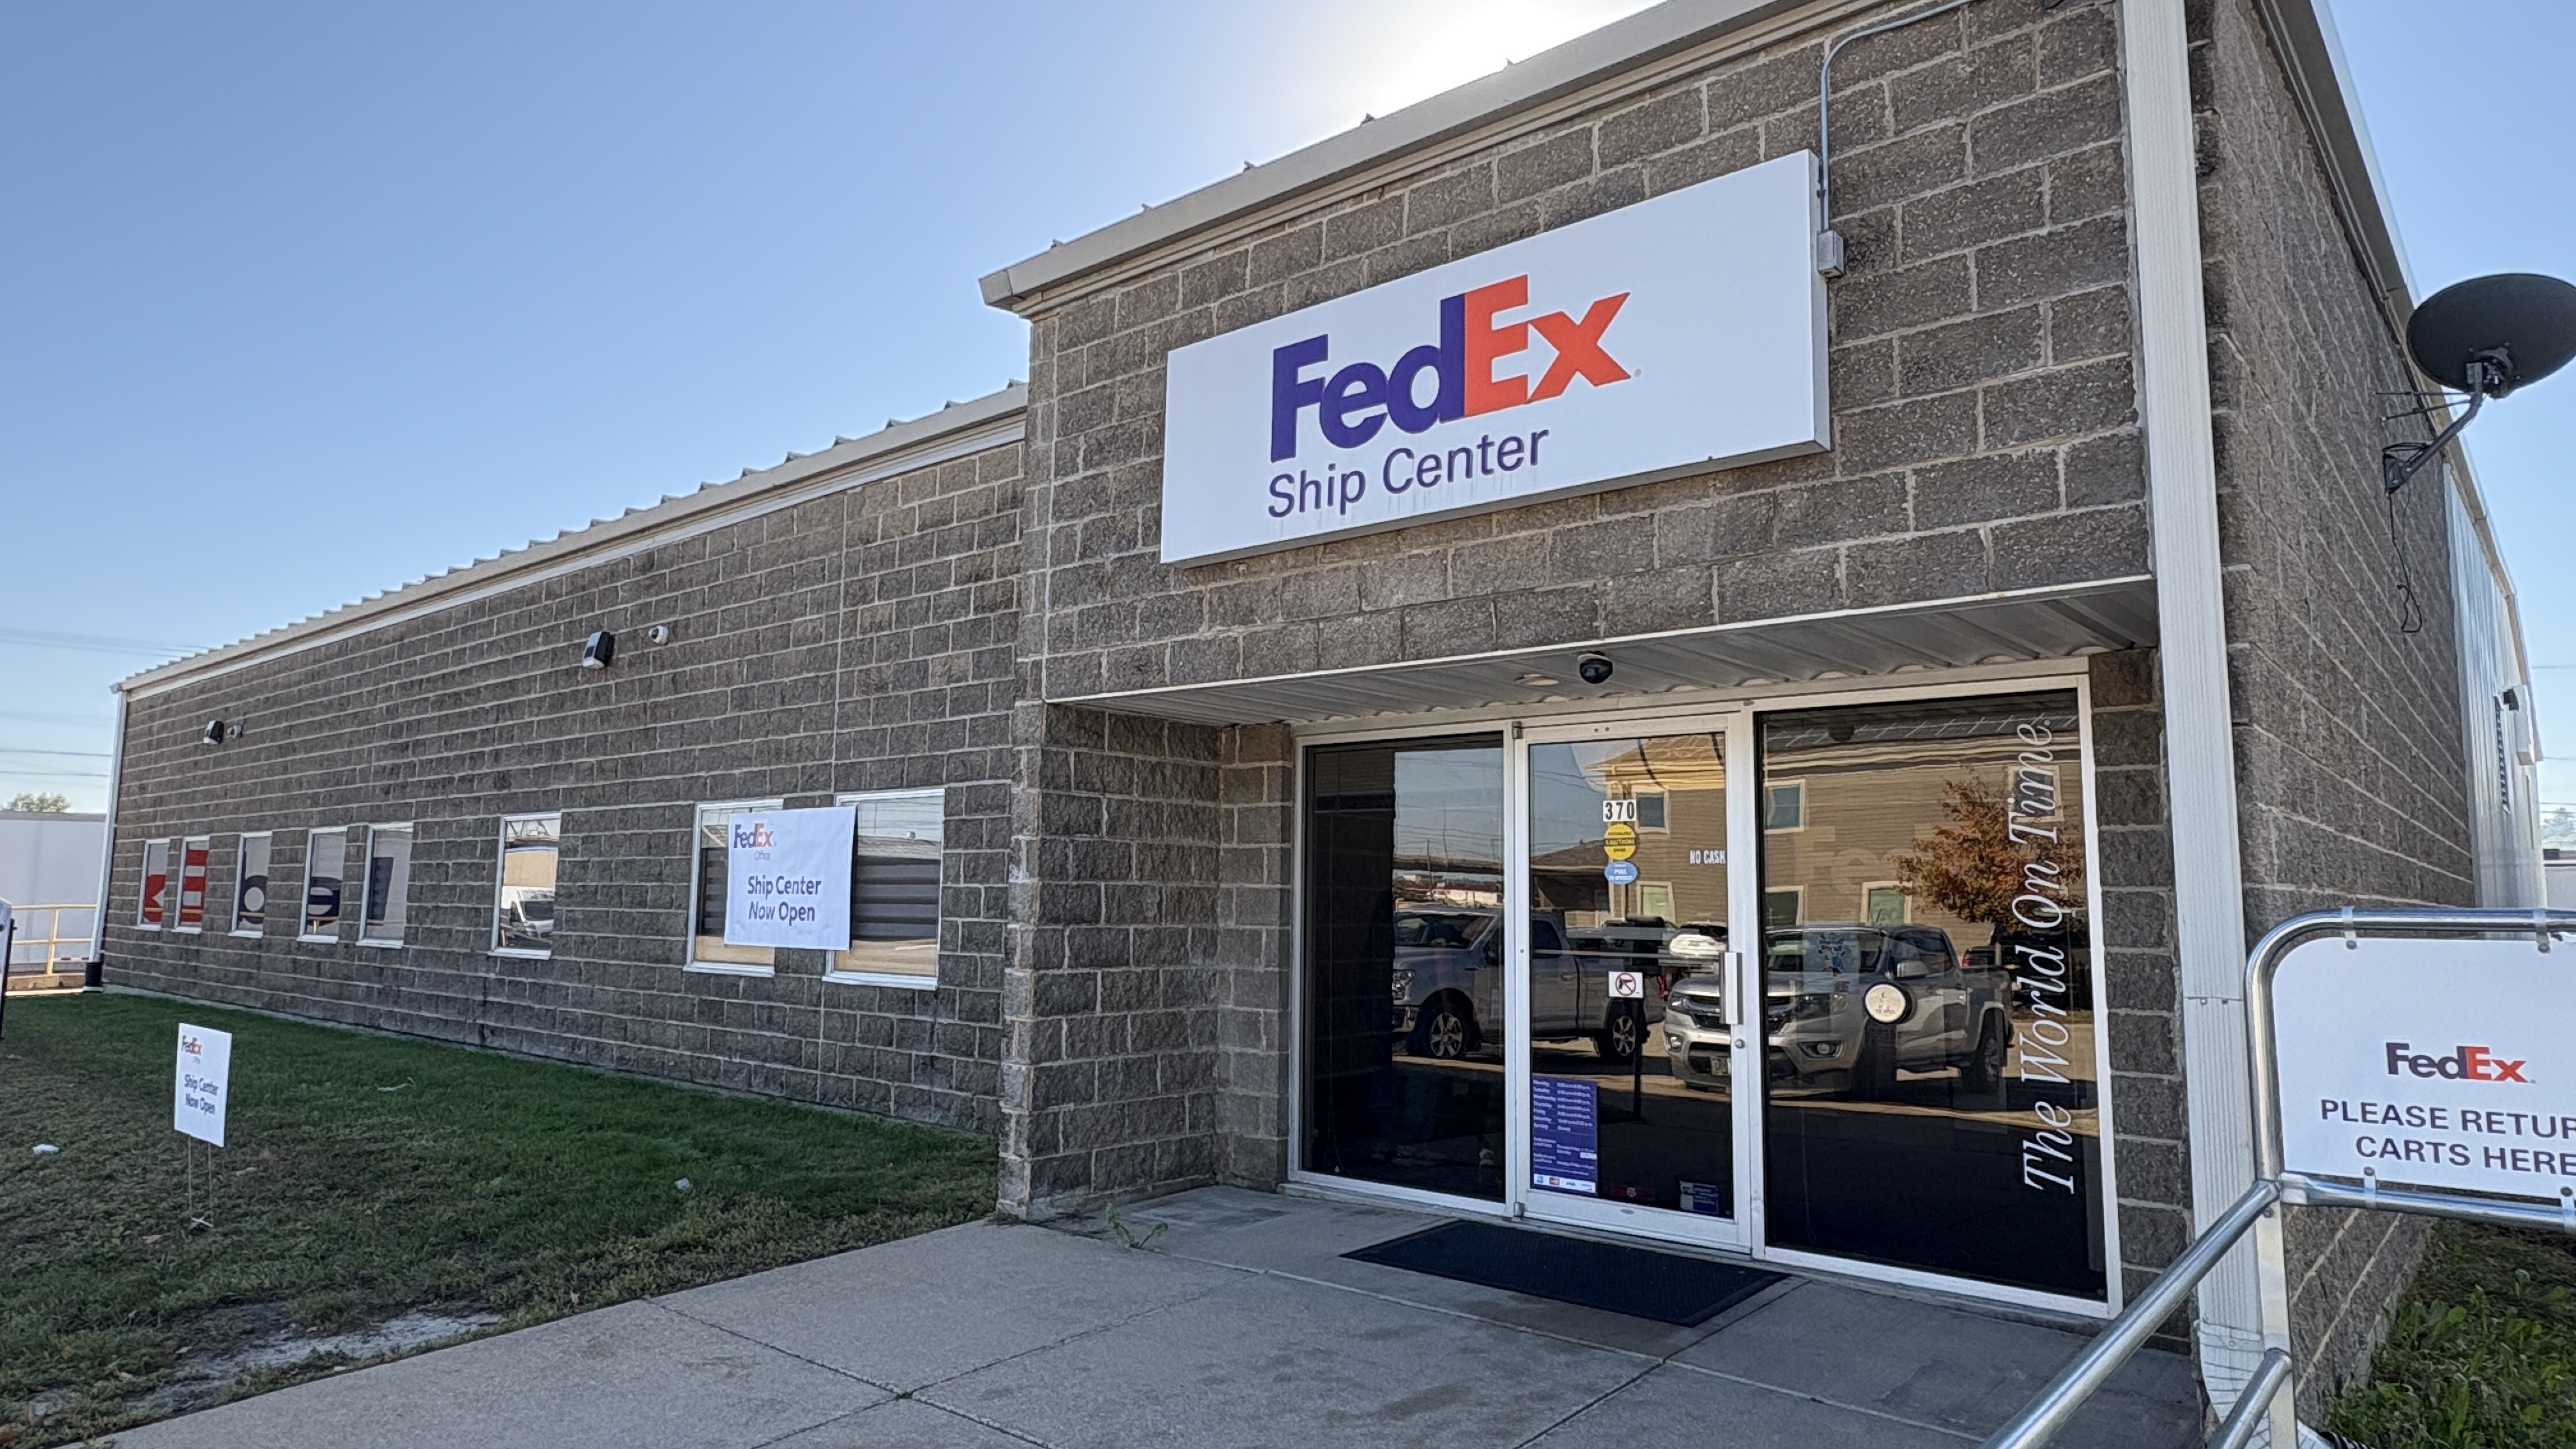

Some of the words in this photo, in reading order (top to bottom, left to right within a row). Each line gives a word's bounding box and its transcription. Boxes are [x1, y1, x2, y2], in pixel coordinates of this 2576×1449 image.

[1270, 274, 1631, 463] FedEx
[1268, 465, 1365, 518] Ship
[1383, 429, 1549, 494] Center
[1605, 801, 1634, 820] 370
[733, 823, 774, 848] FedEx
[1689, 850, 1701, 864] NO
[1703, 850, 1726, 864] CASH
[747, 875, 773, 899] Ship
[776, 876, 822, 896] Center
[2012, 859, 2063, 928] On
[747, 901, 775, 921] Now
[778, 903, 815, 926] Open
[2013, 942, 2071, 1085] World
[2386, 1042, 2530, 1084] FedEx
[2321, 1099, 2449, 1130] PLEASE
[2023, 1101, 2074, 1195] The
[2356, 1136, 2471, 1166] CARTS
[2483, 1146, 2576, 1176] HERE
